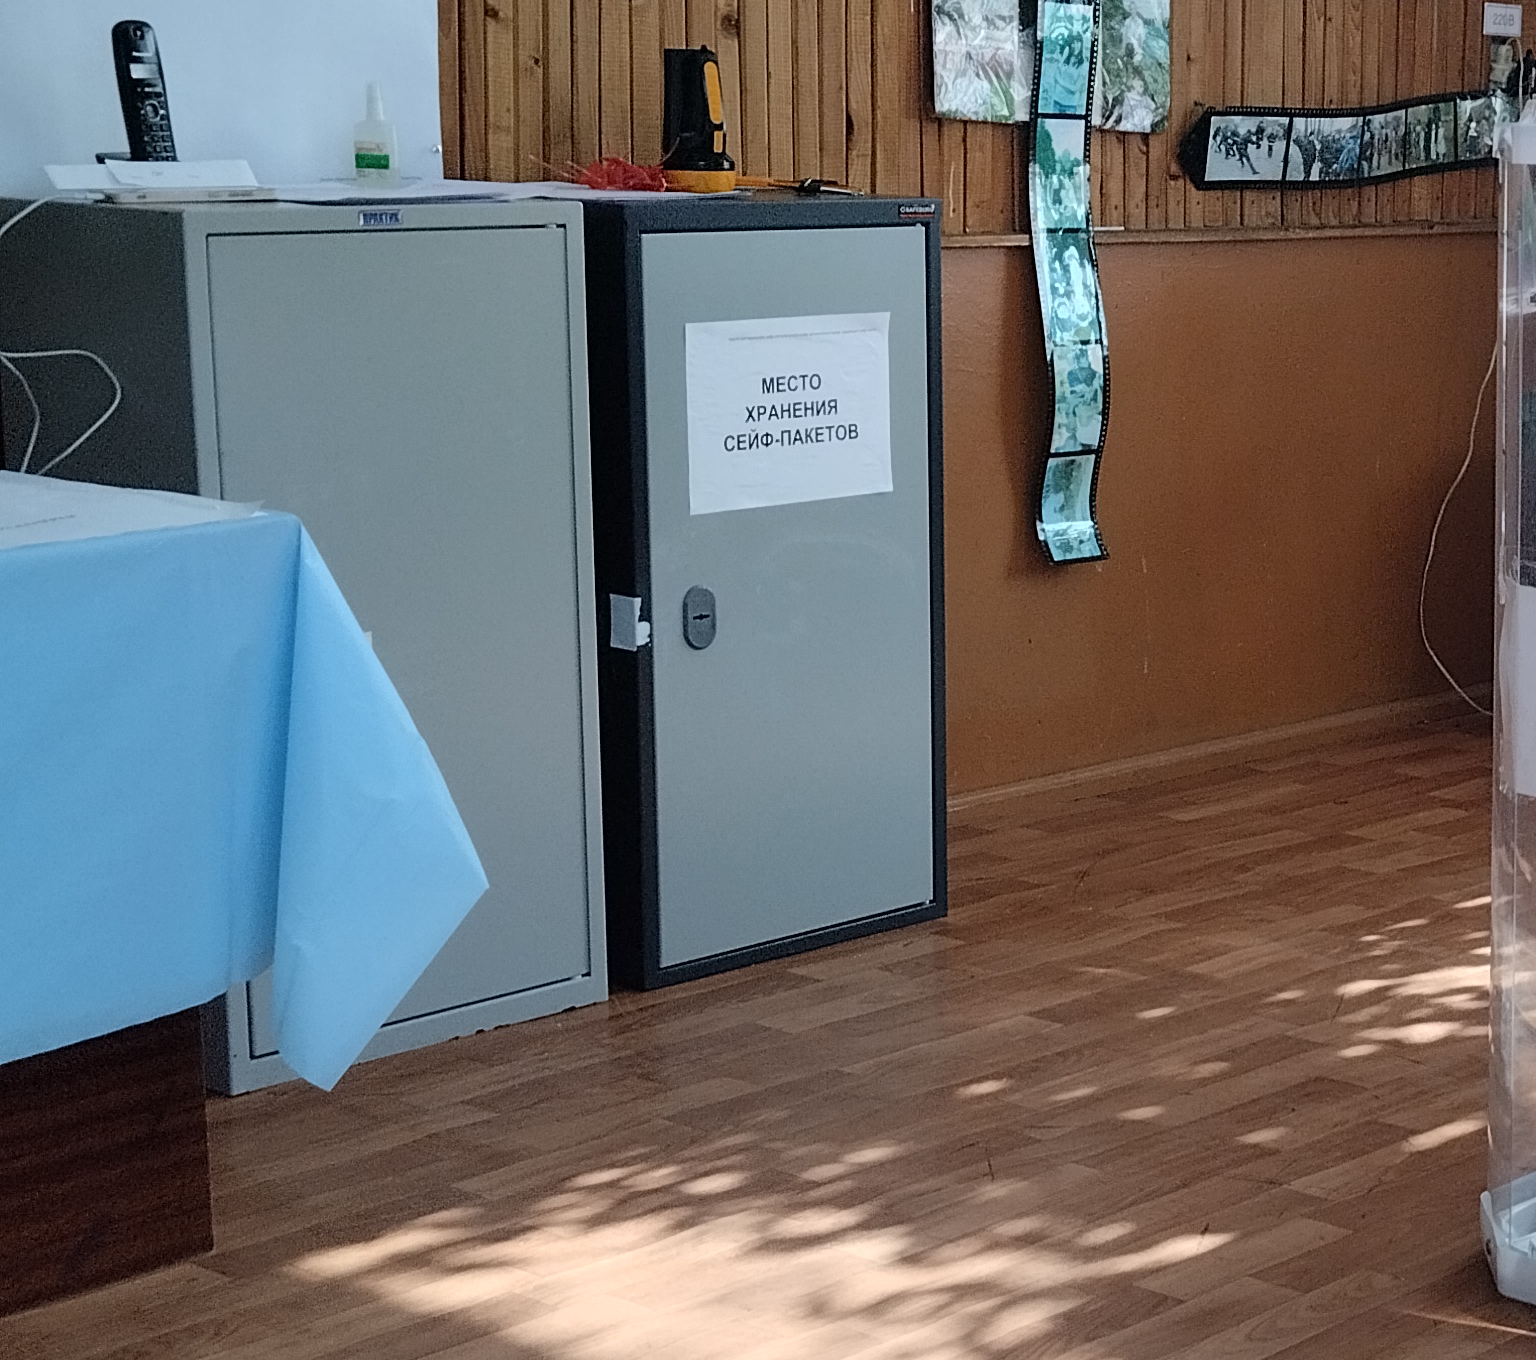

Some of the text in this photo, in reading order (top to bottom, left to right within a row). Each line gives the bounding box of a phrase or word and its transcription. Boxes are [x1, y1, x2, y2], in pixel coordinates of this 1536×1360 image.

[761, 373, 822, 394] МЕСТО
[745, 398, 838, 423] ХРАНЕНИЯ
[723, 423, 859, 452] СЕЙФ-ПАКЕТОВ
